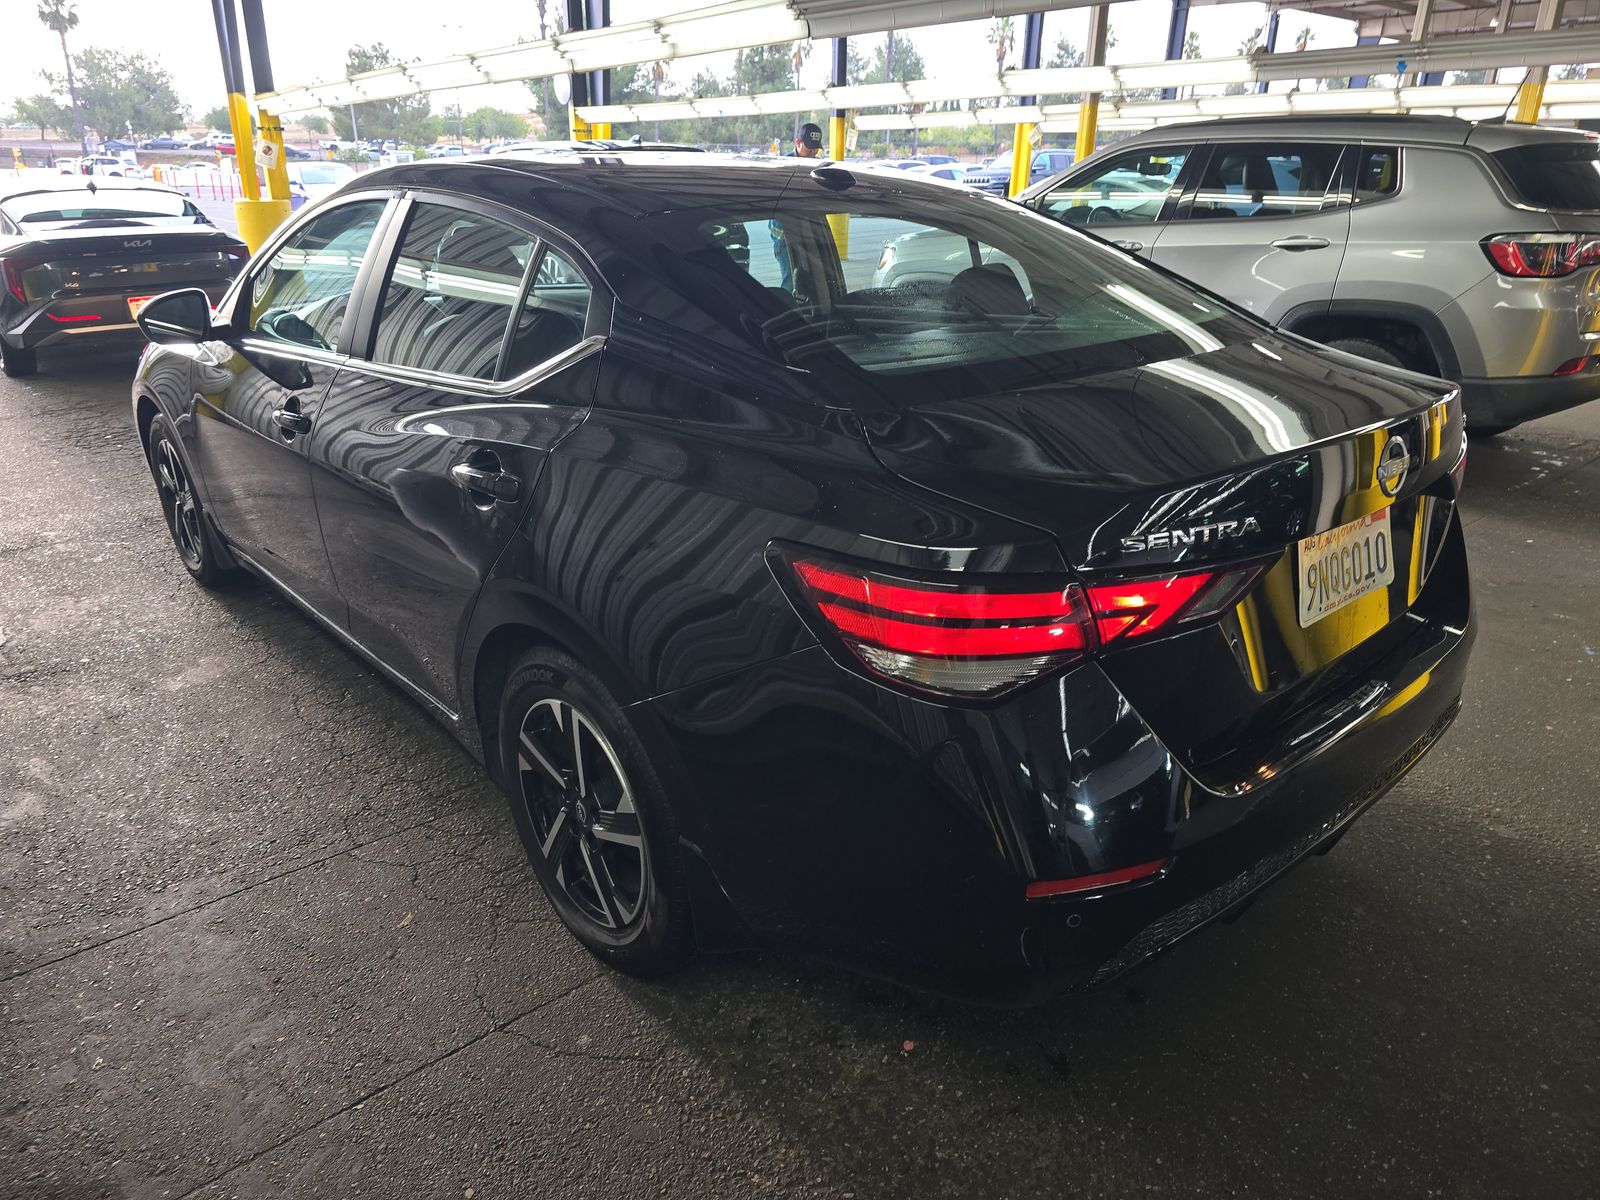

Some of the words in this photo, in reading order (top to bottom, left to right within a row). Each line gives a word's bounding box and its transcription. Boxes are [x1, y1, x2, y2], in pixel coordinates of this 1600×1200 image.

[1120, 516, 1261, 553] SENTRA
[1304, 536, 1316, 553] AUG
[1307, 531, 1387, 612] 9NQG010
[1324, 582, 1371, 612] dmv.ca.gov
